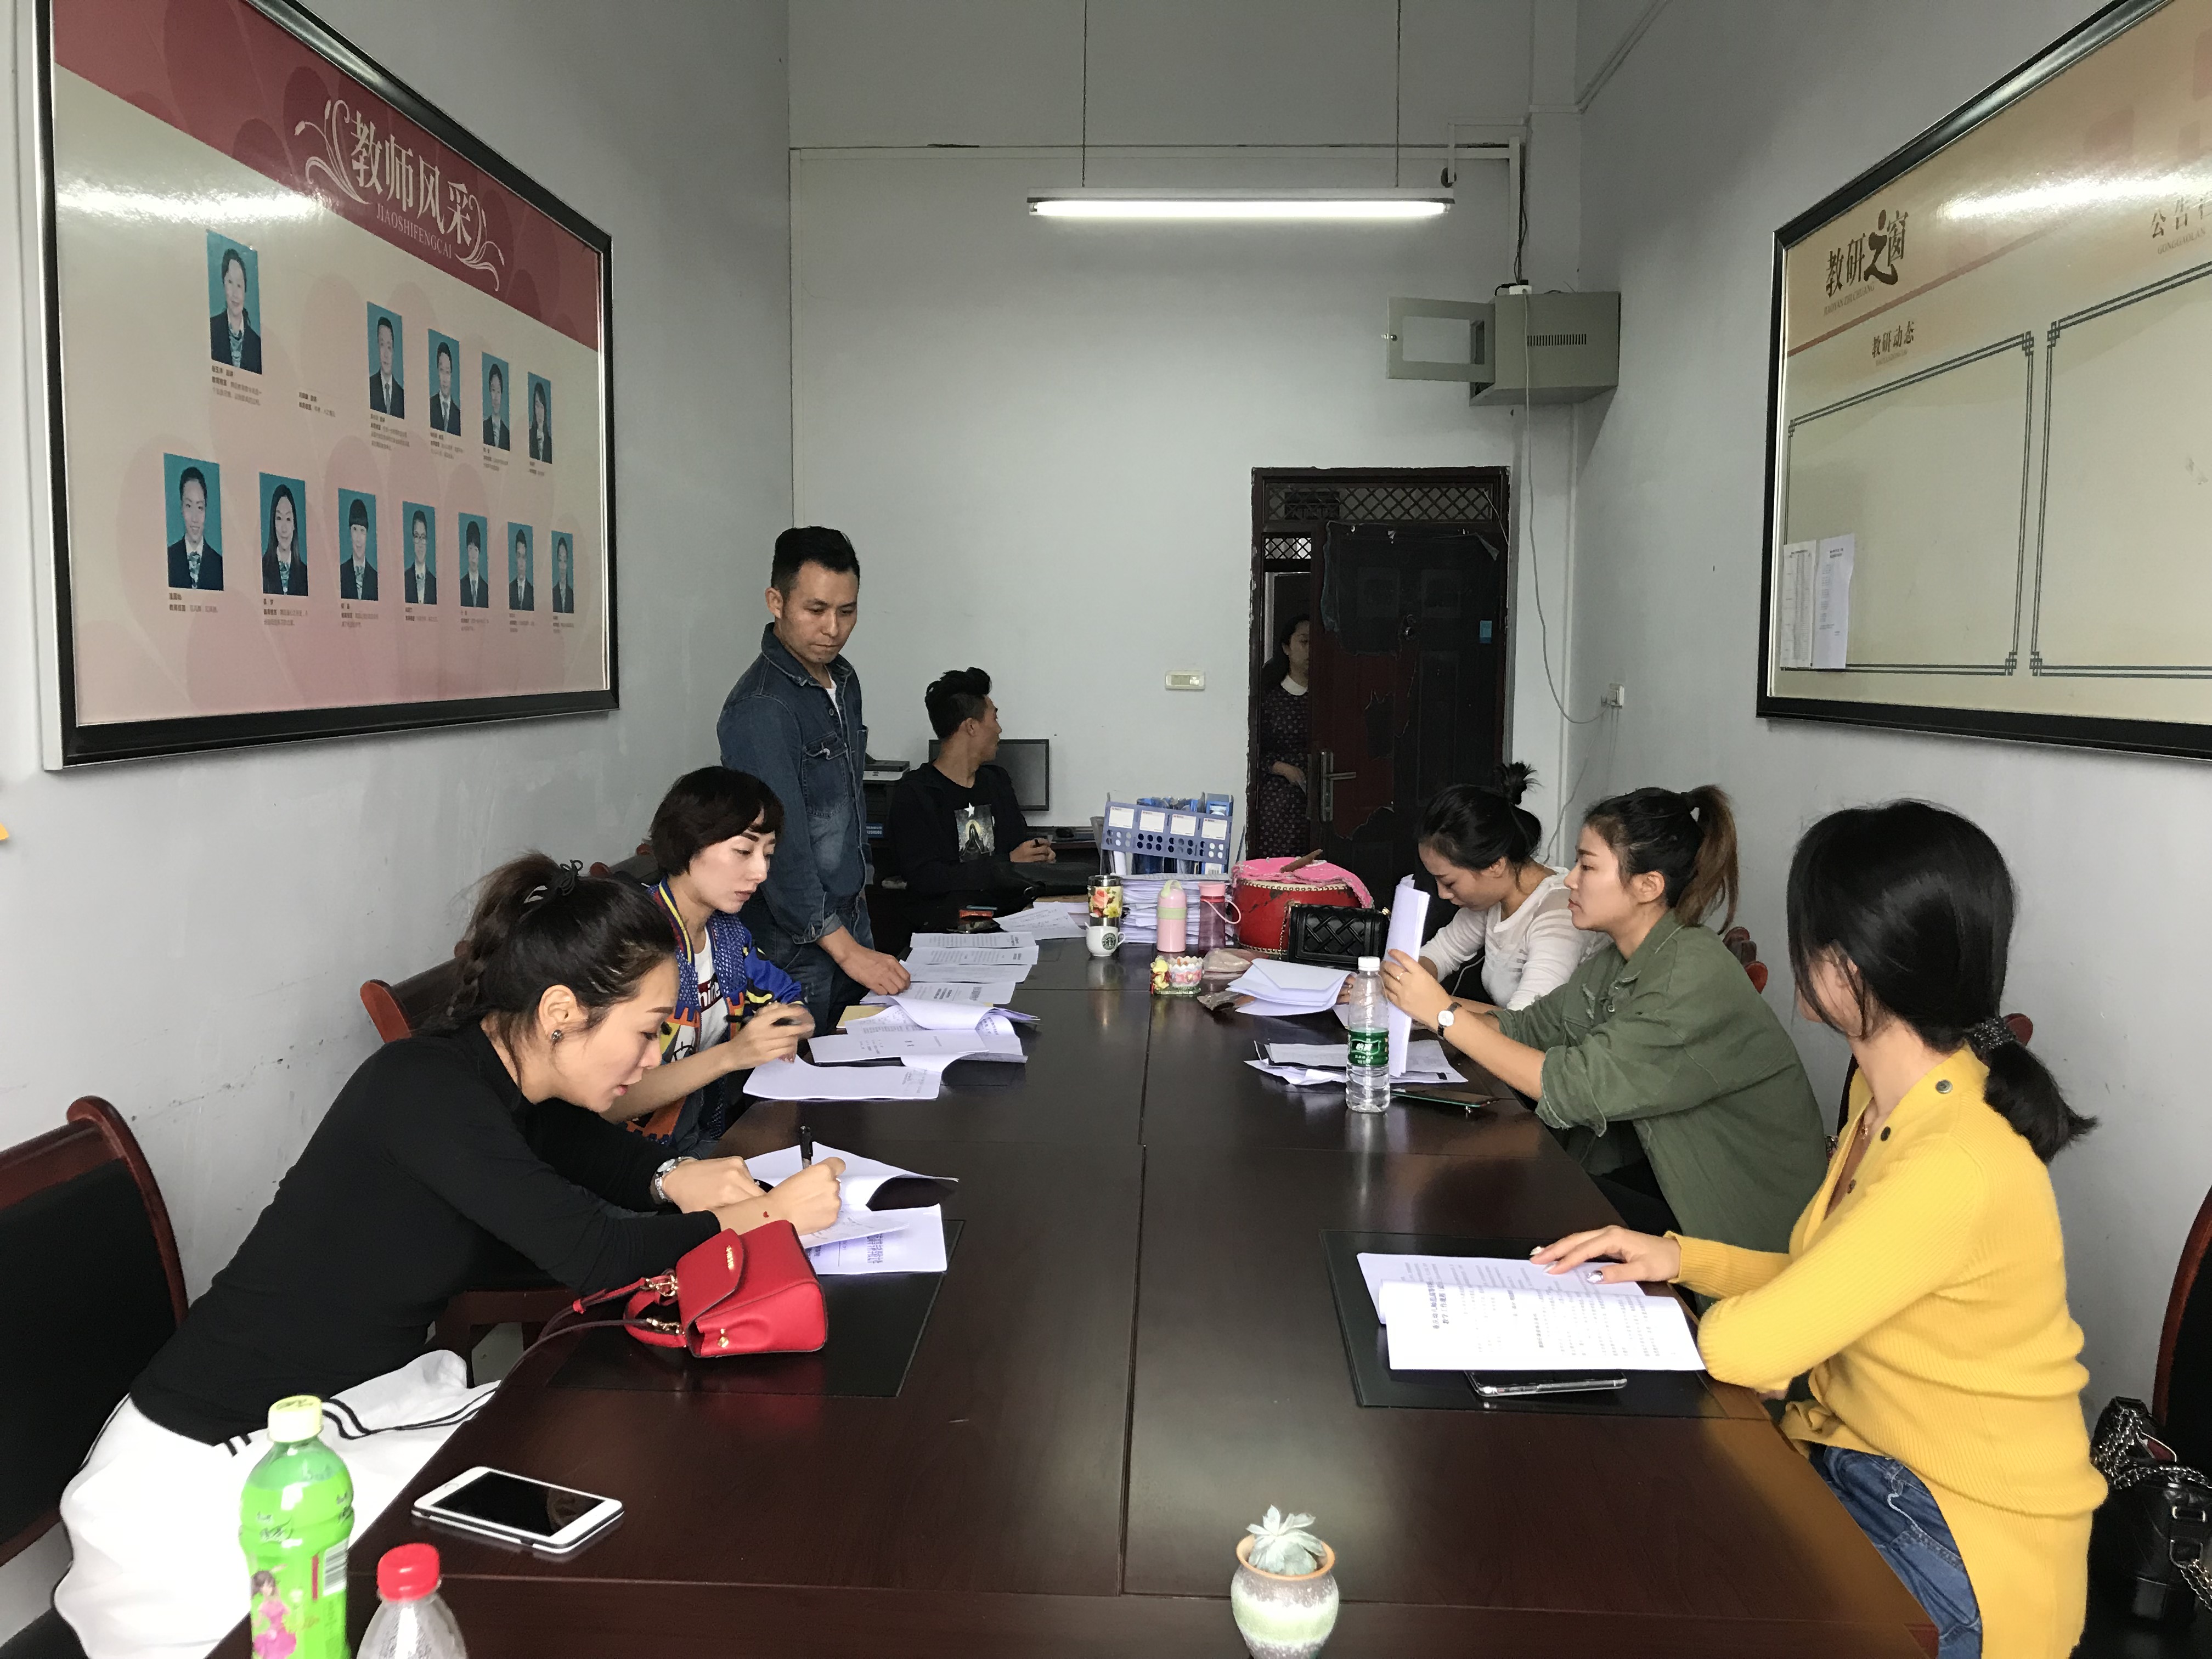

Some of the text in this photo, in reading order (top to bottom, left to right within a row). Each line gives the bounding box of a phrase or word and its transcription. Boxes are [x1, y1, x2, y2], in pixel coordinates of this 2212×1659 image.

[351, 110, 471, 246] 教师风采
[376, 202, 452, 258] JIAOSHIFENGCAI
[1825, 209, 1909, 298] 教研之窗
[1872, 320, 1914, 358] 教研动态
